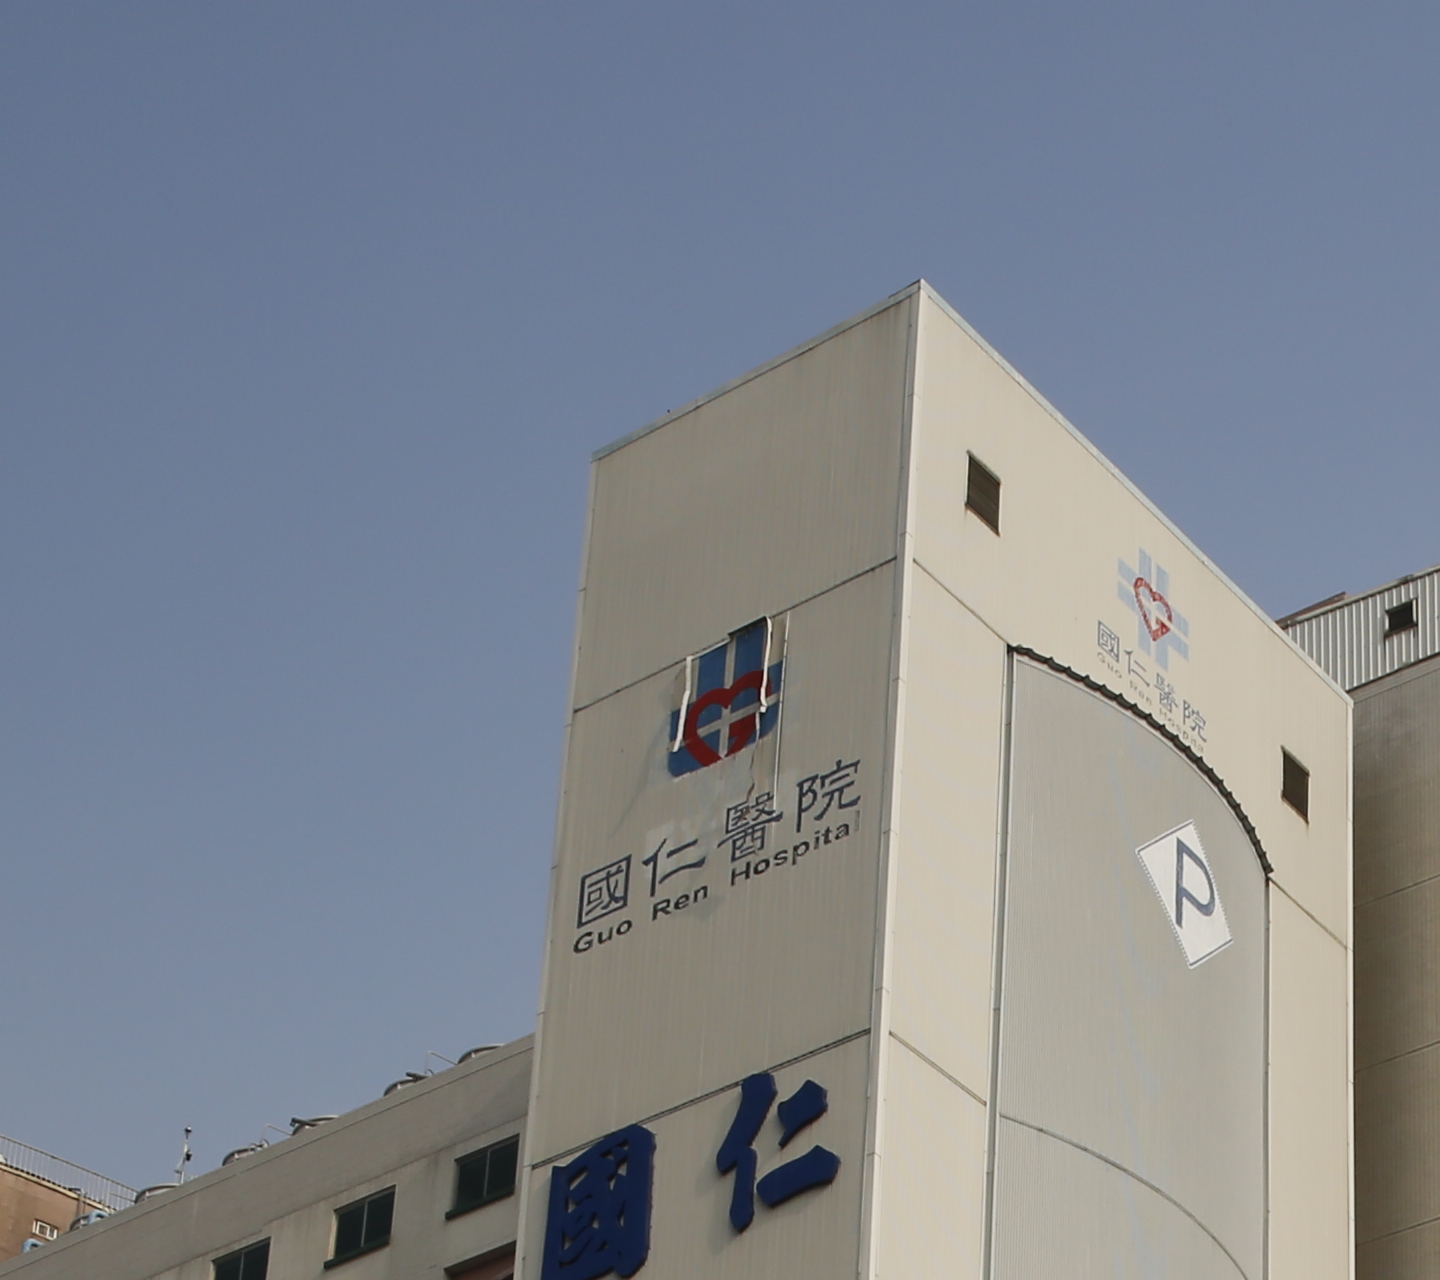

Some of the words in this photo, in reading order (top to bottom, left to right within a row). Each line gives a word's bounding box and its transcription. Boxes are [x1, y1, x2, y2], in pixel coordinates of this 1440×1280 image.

[1097, 620, 1207, 743] 國仁醫院
[1159, 707, 1205, 754] Hospita
[572, 918, 634, 955] Guo
[651, 885, 709, 921] Ren
[730, 811, 860, 887] Hospital
[576, 758, 862, 929] 國仁醫院
[1175, 837, 1217, 929] P
